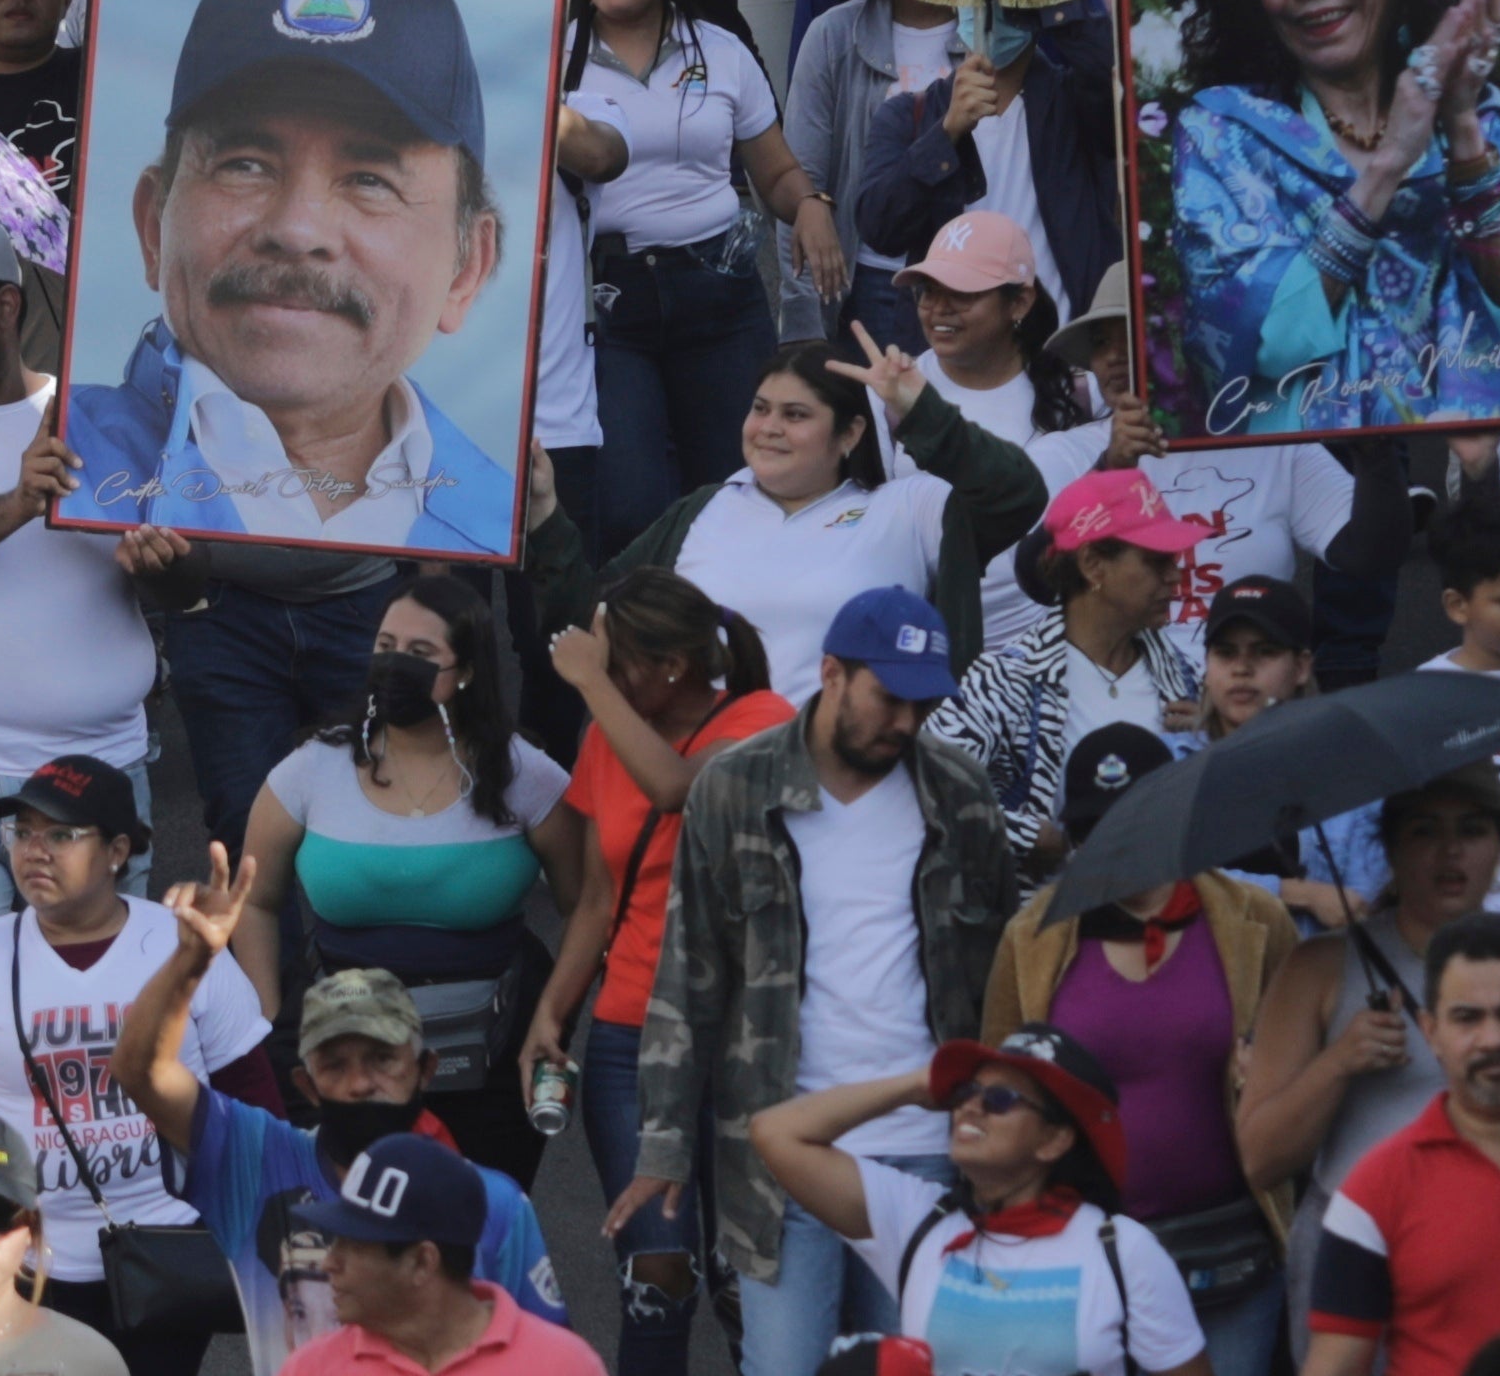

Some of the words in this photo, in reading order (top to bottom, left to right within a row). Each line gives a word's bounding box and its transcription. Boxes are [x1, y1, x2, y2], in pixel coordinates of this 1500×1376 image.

[1203, 371, 1277, 436] Cra.
[1276, 360, 1409, 420] Rosario
[172, 465, 271, 504] Daniel
[276, 466, 358, 502] Ortega
[362, 463, 461, 502] Saavedra
